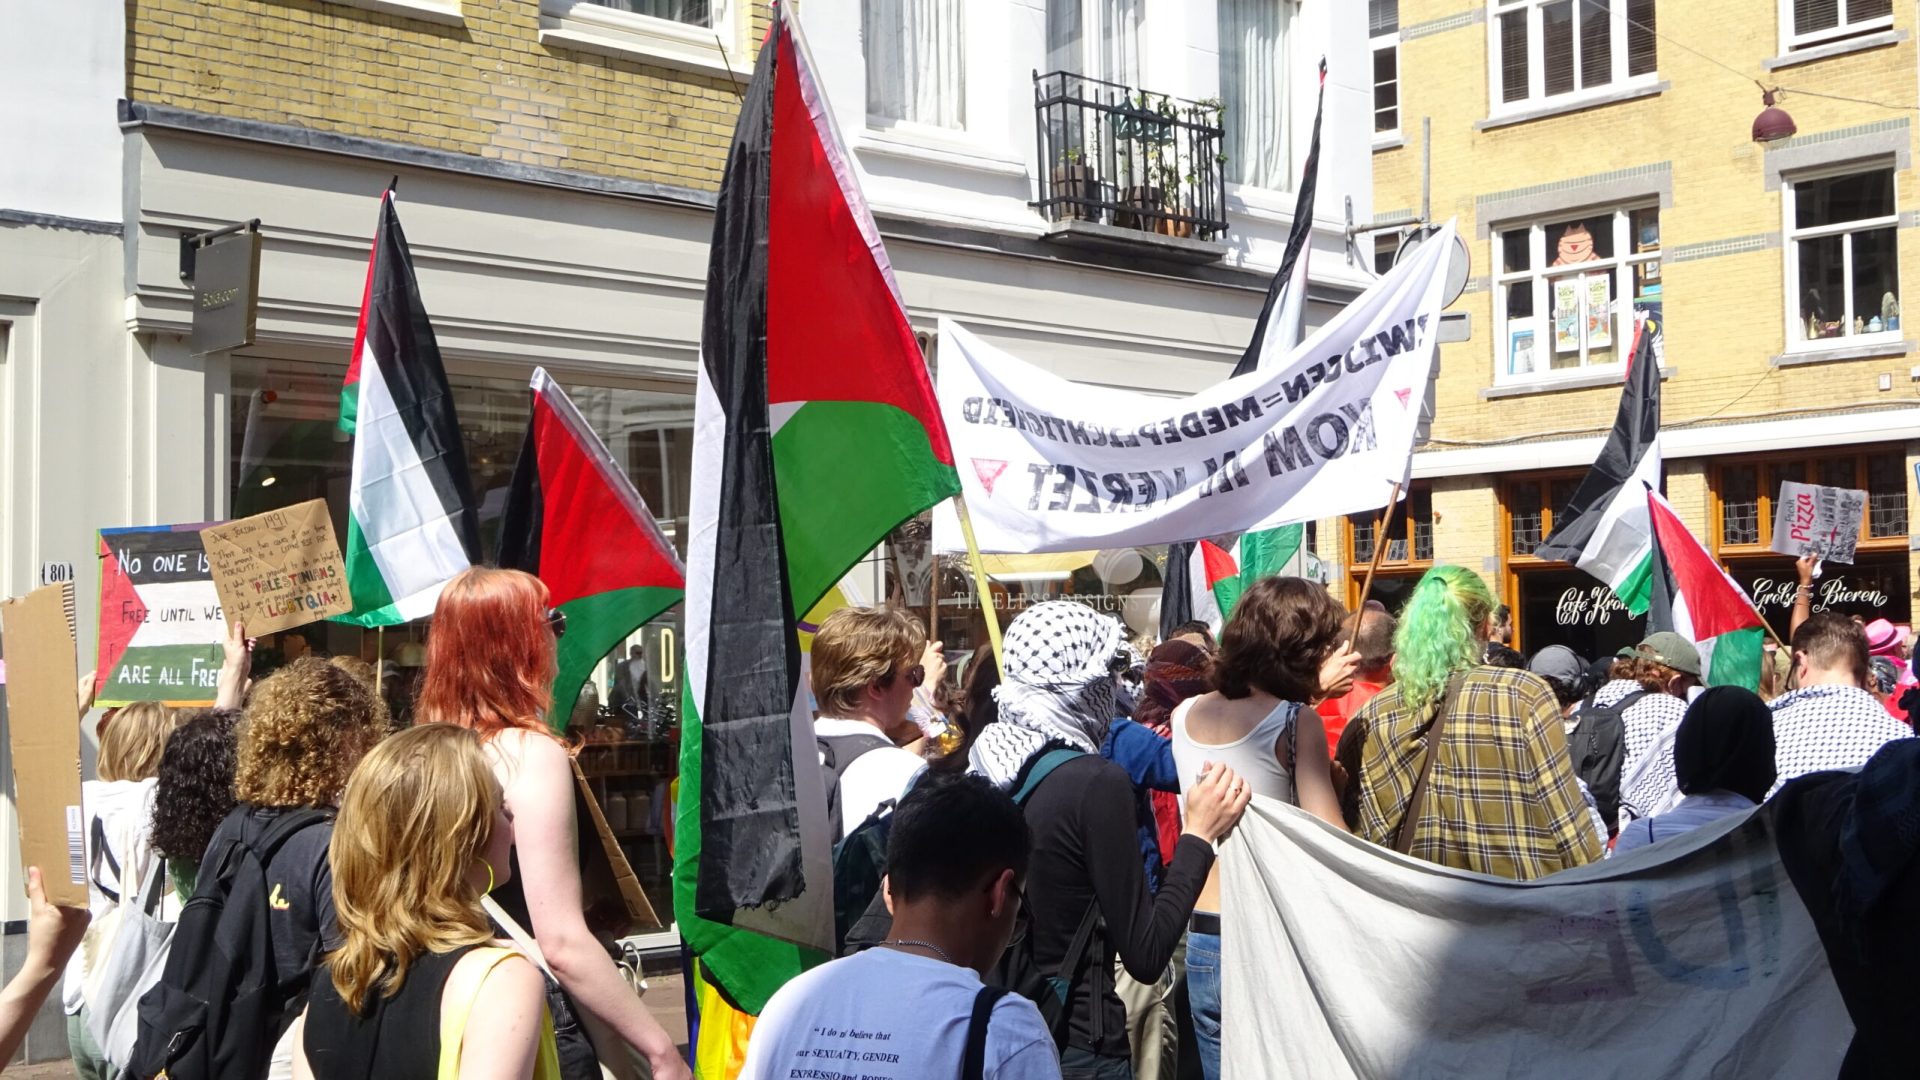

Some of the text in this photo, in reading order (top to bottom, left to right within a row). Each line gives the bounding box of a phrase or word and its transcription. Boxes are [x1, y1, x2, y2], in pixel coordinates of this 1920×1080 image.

[263, 511, 288, 528] 1991
[1790, 493, 1815, 542] Pizza
[50, 564, 66, 582] 80
[153, 554, 187, 573] ONE
[198, 552, 210, 573] IS
[254, 565, 335, 594] PALESTINIANS
[1556, 587, 1589, 625] Café
[1752, 575, 1889, 616] Grolsce Bieren
[122, 600, 222, 624] FREE UNTIL WE
[118, 664, 152, 684] ARE
[158, 666, 184, 686] ALL
[827, 1028, 837, 1037] do
[875, 1032, 892, 1041] that
[862, 1052, 900, 1063] GENDER
